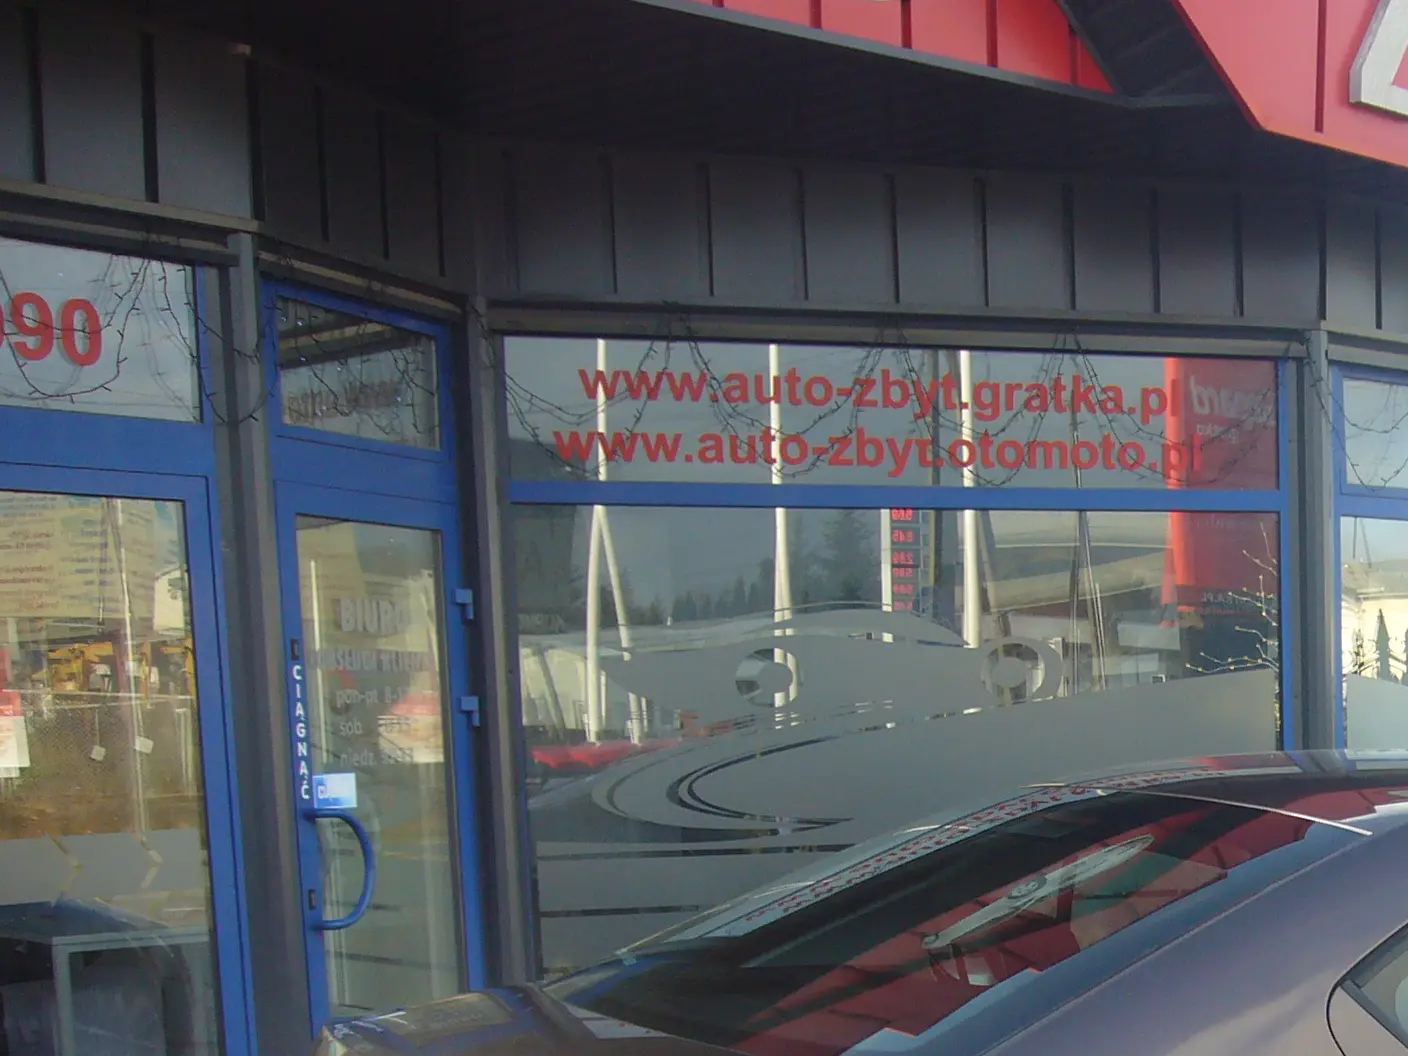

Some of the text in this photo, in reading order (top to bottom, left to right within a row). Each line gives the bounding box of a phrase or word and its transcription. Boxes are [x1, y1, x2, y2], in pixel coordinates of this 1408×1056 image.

[0, 292, 102, 367] 90
[578, 366, 1180, 422] www.auto-zbyt.gratka.pl
[553, 427, 1204, 479] www.auto-zbyt.otomoto.pl
